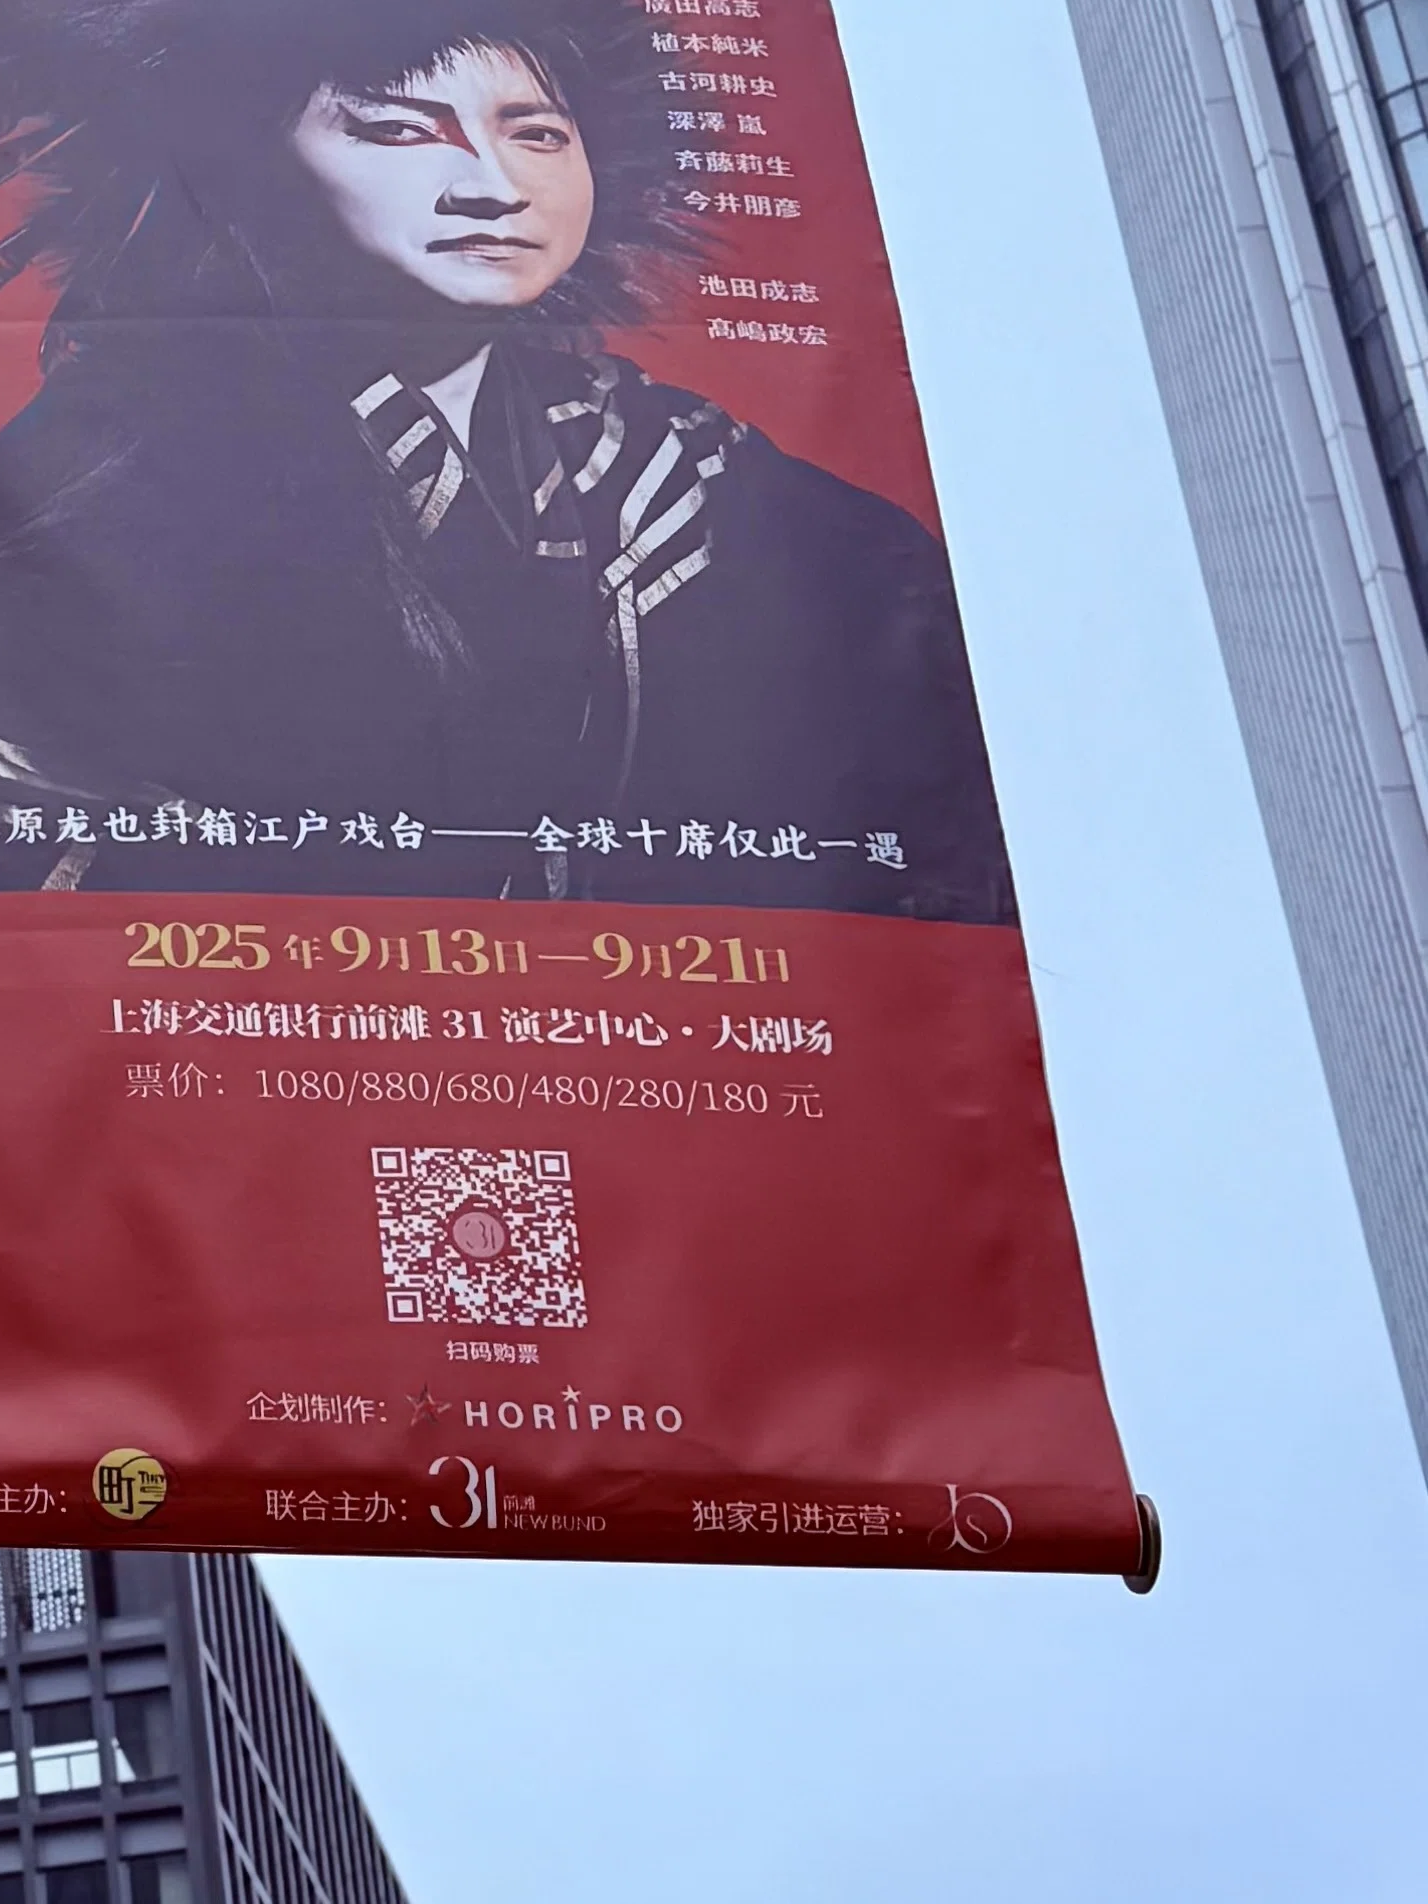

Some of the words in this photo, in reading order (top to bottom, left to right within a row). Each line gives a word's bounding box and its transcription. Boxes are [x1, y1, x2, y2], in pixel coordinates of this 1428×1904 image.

[698, 274, 820, 304] 池田成志
[100, 997, 432, 1042] 上海交通银行前滩
[254, 1066, 768, 1116] 1080/880/680/480/280/180
[780, 1081, 824, 1119] 元
[446, 1340, 541, 1366] 扫码购票
[429, 1456, 498, 1530] 31
[504, 1514, 547, 1530] NEW
[552, 1516, 606, 1532] BUND
